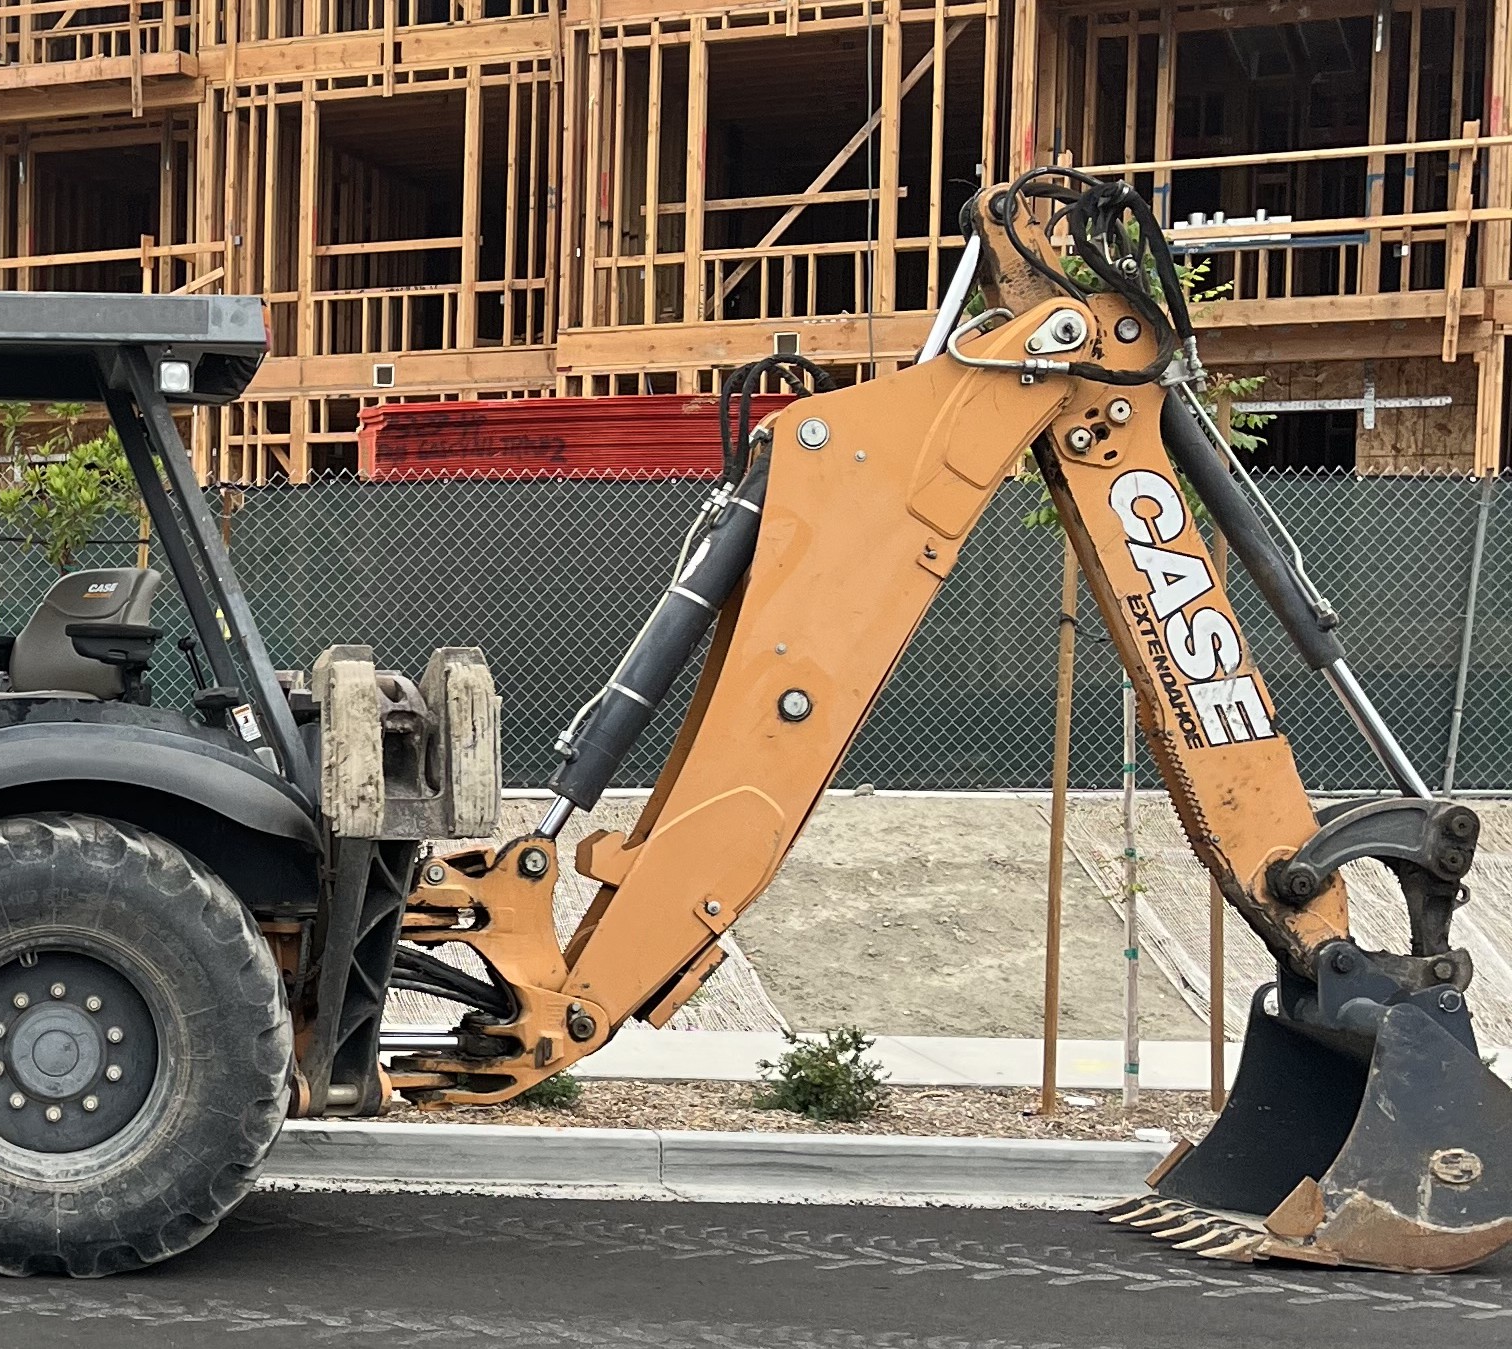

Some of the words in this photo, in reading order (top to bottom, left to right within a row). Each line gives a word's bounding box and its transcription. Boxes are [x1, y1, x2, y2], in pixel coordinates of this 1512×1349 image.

[88, 582, 118, 592] CASE
[1109, 469, 1278, 747] CASE
[1127, 594, 1204, 749] EXTENDAHOE
